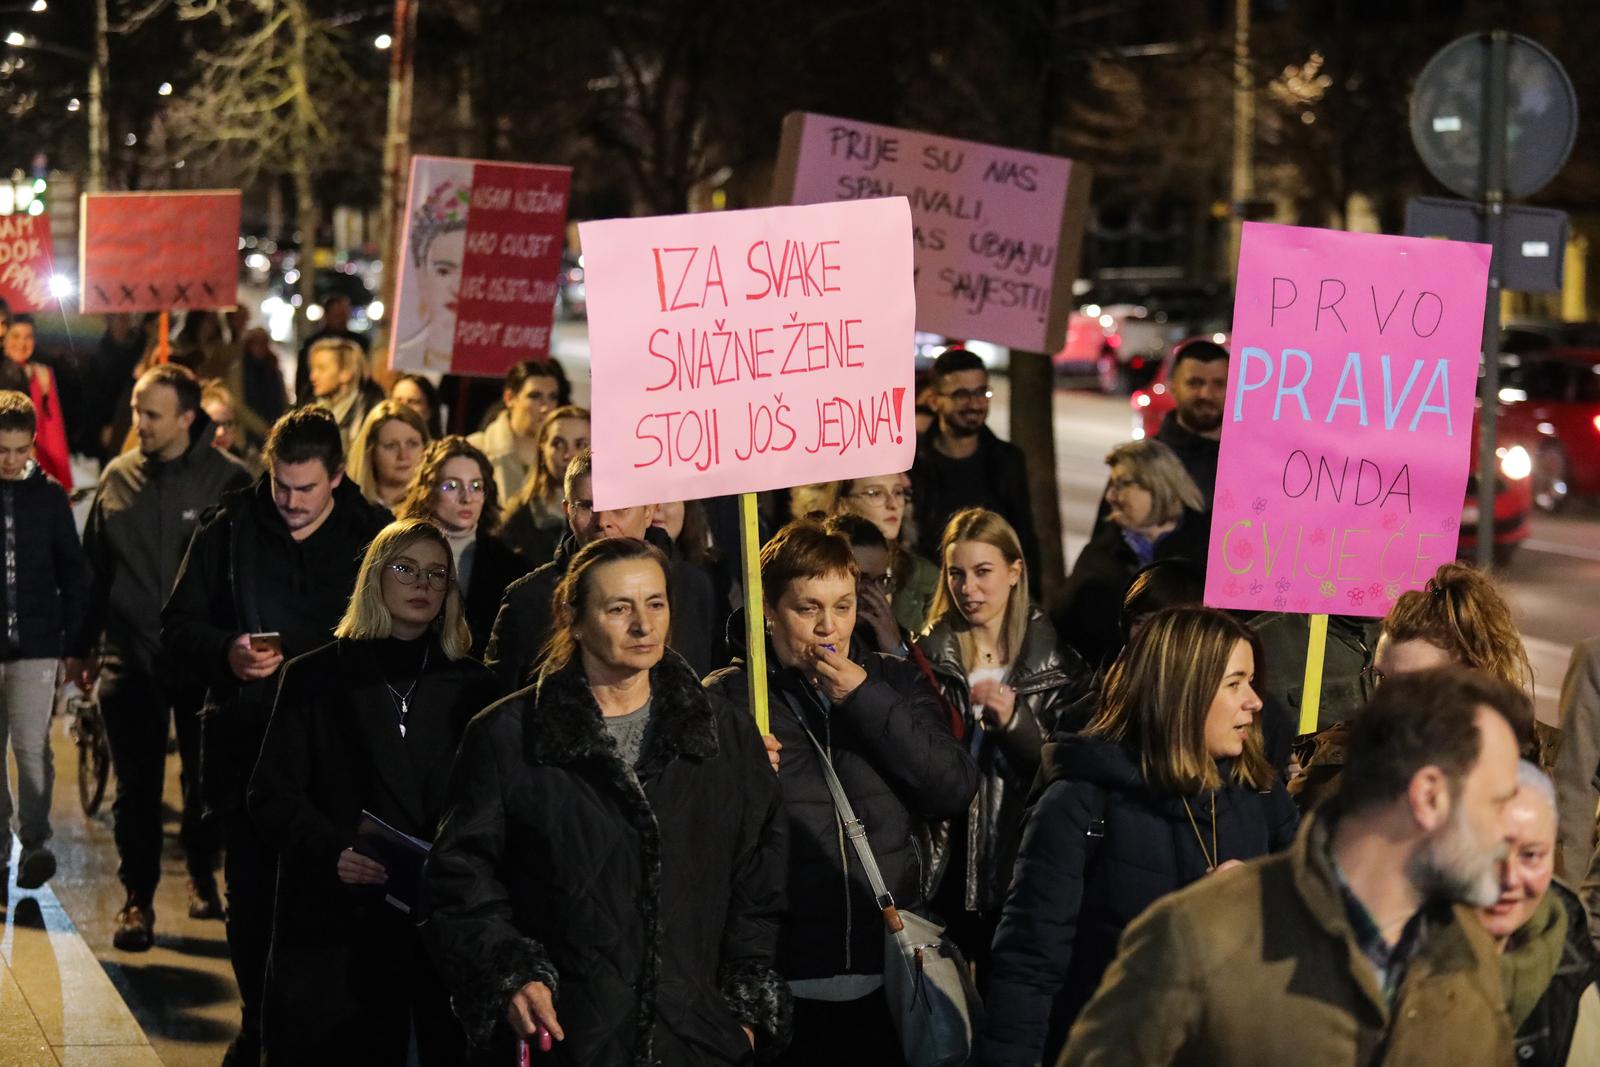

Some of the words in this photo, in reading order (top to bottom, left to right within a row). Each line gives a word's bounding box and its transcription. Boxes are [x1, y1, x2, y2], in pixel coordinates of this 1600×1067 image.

[829, 126, 899, 171] PRIJE
[922, 146, 965, 173] SU
[983, 160, 1038, 192] NAS
[652, 245, 728, 312] IZA
[746, 239, 841, 301] SVAKE
[1271, 277, 1444, 338] PRVO
[646, 318, 775, 392] SNAŽNE
[780, 311, 865, 375] ŽENE
[1233, 346, 1454, 437] PRAVA
[634, 408, 720, 472] STOJI
[735, 392, 797, 461] JOŠ
[805, 387, 906, 456] JEDNA!
[1283, 450, 1412, 514] ONDA
[1222, 516, 1443, 585] CVIJEĆE
